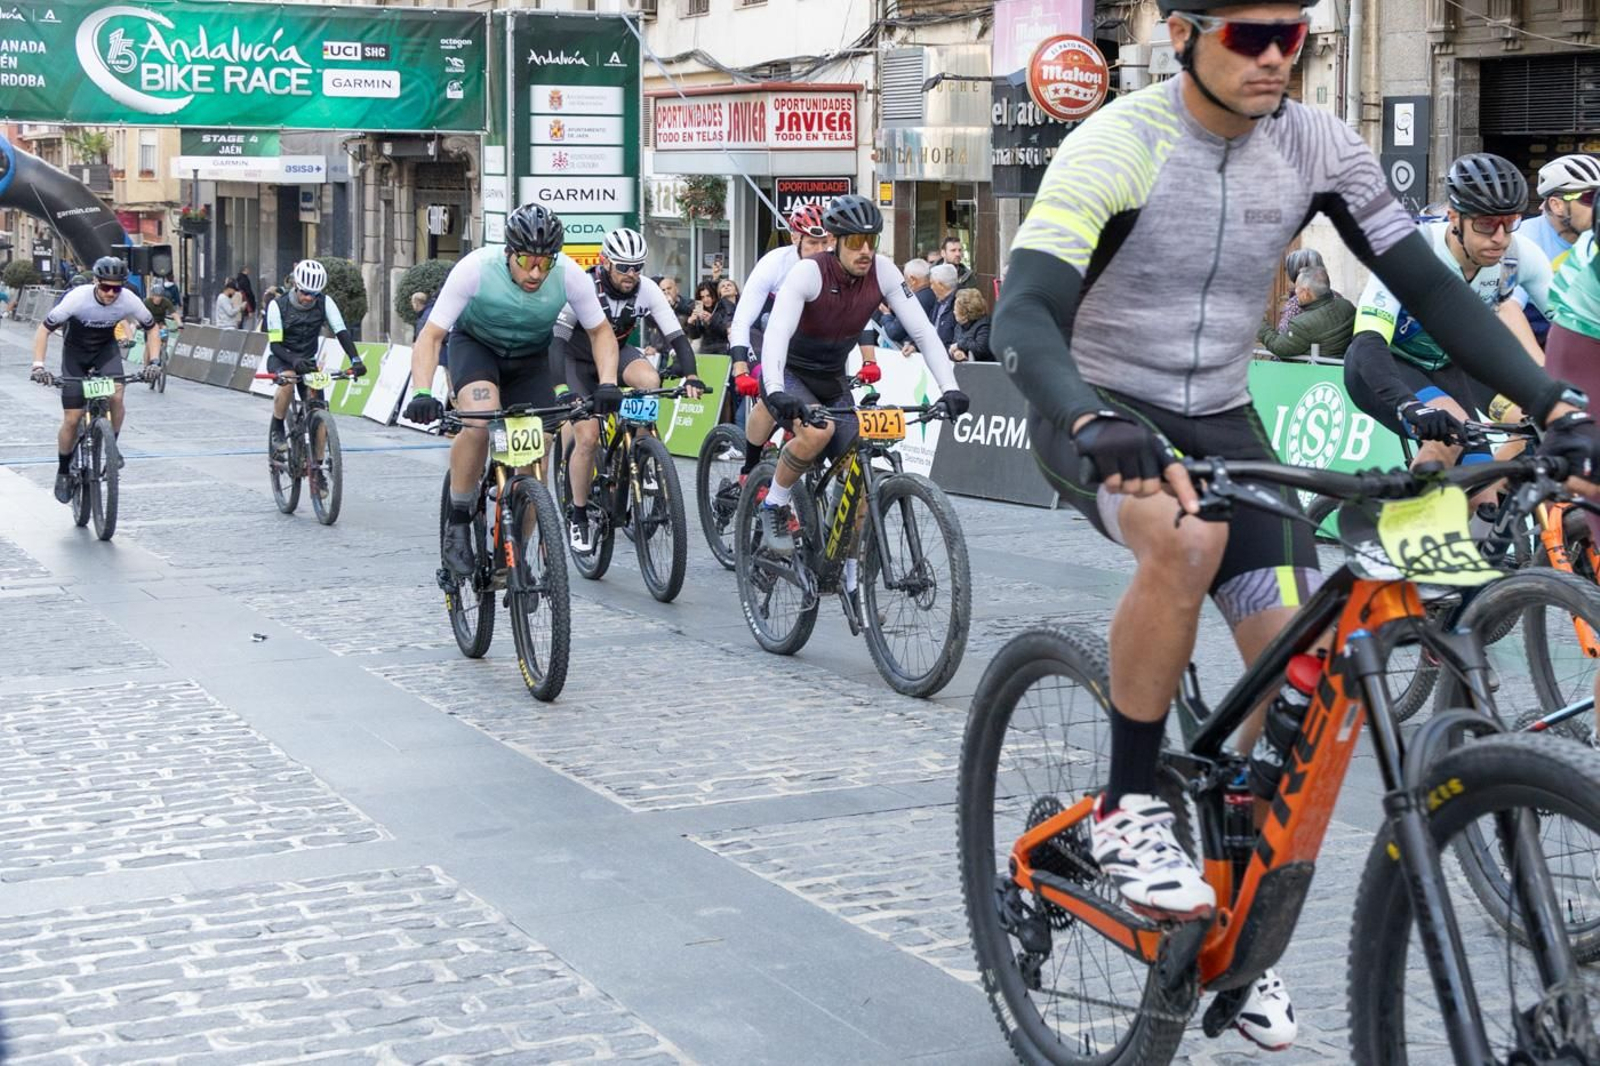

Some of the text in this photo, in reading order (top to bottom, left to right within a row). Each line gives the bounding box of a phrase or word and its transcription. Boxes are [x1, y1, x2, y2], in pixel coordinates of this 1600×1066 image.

[0, 40, 47, 54] ANADA
[139, 21, 312, 68] Andalucía
[330, 45, 386, 58] UCI SHC
[0, 53, 18, 69] ÉN
[527, 48, 590, 67] Andalucía
[0, 73, 46, 88] RDOBA
[141, 62, 313, 96] BIKE RACE
[1042, 64, 1103, 85] Mahou
[331, 78, 393, 89] GARMIN
[774, 98, 852, 111] OPORTUNIDADES
[657, 103, 723, 129] OPORTUNIDADES
[727, 101, 767, 143] JAVIER
[776, 112, 852, 132] JAVIER
[202, 135, 258, 143] STAGE 4
[658, 131, 724, 142] TODO EN TELAS
[775, 133, 853, 141] TODO EN TELAS
[218, 145, 242, 155] JAÉN
[920, 147, 968, 164] HORA
[538, 188, 617, 201] GARMIN
[57, 206, 102, 219] garmin.com
[564, 224, 606, 234] KODA
[88, 381, 112, 394] 1071
[624, 400, 657, 417] 407-2
[861, 411, 902, 433] 512-1
[953, 412, 1031, 450] GARM
[511, 428, 541, 452] 620
[826, 452, 860, 560] SCOTT
[1399, 532, 1483, 576] 685
